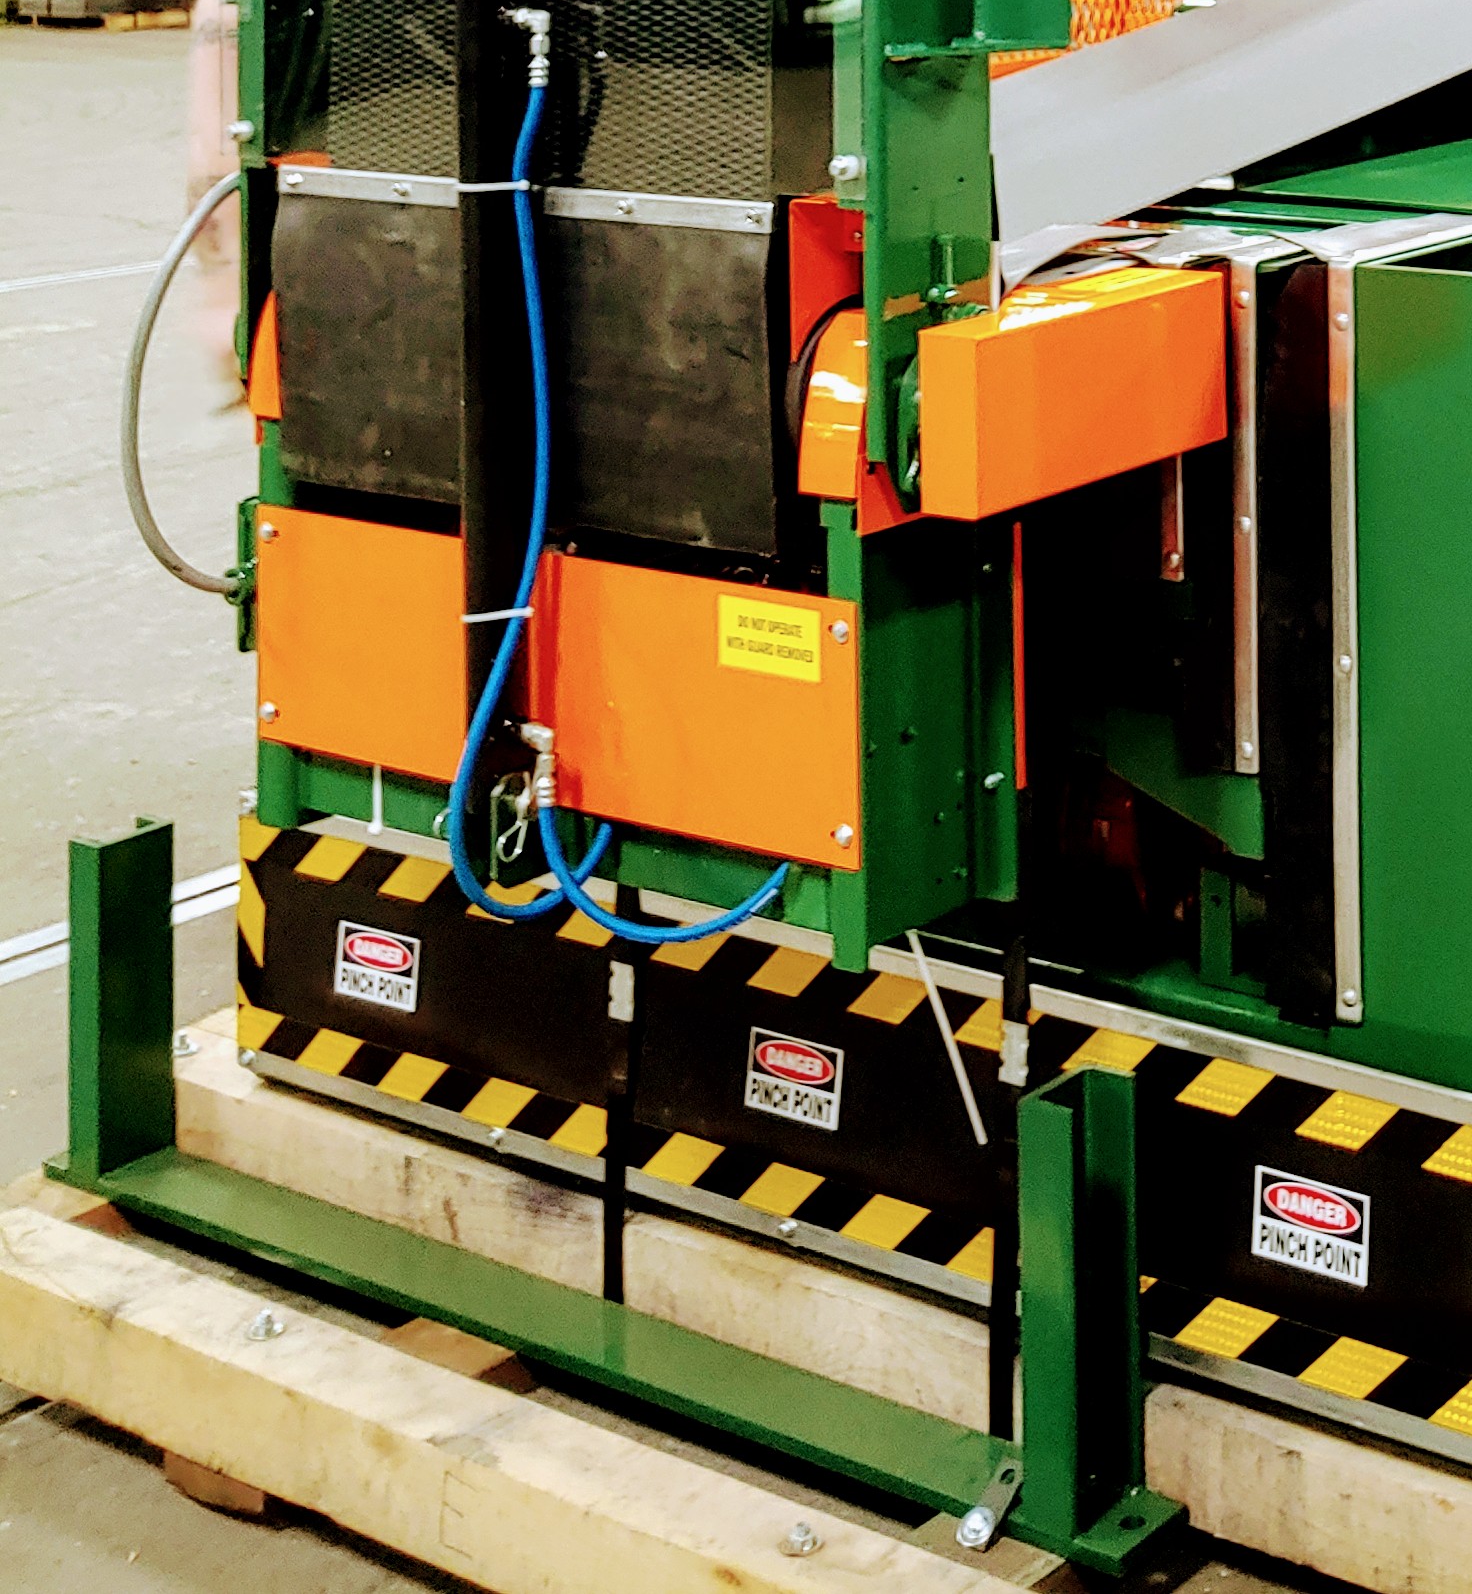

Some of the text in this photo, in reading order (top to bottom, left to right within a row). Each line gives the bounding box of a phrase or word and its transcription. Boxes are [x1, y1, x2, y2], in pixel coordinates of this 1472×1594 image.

[353, 937, 404, 966] DANGER
[340, 967, 412, 1005] PINCH POINT
[766, 1046, 823, 1078] DANGER
[749, 1077, 833, 1123] PINCH POINT
[1277, 1187, 1348, 1228] DANGER
[1259, 1222, 1361, 1278] PINCH POINT
